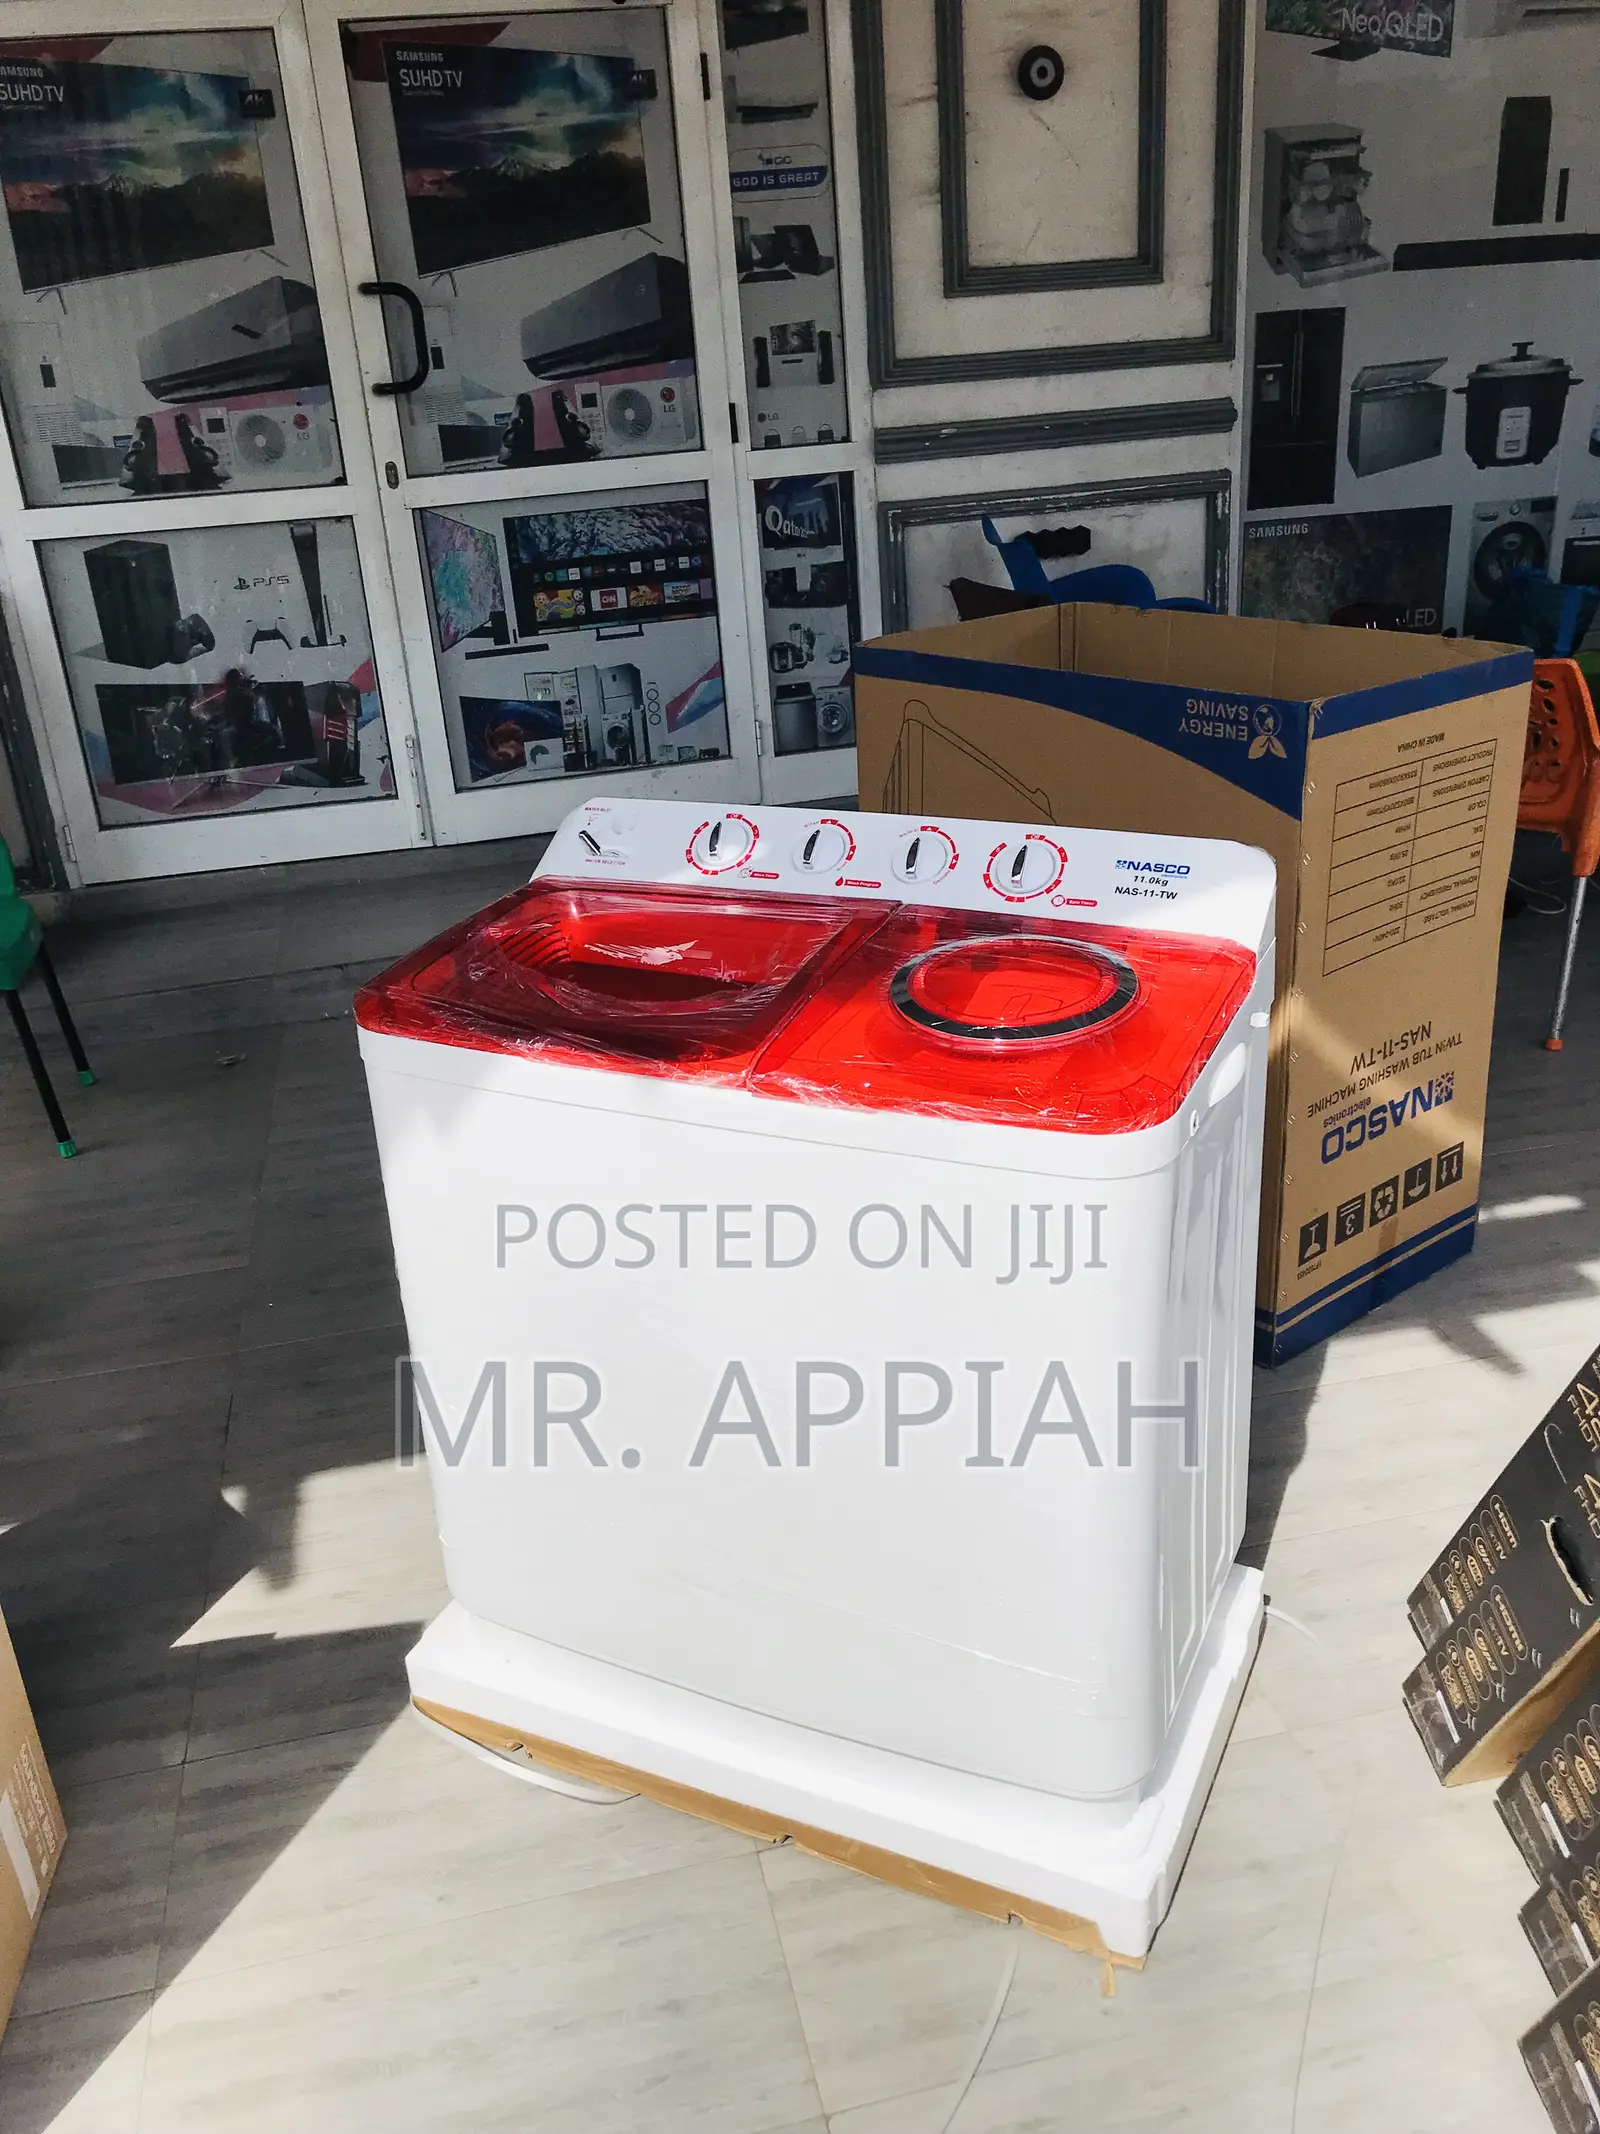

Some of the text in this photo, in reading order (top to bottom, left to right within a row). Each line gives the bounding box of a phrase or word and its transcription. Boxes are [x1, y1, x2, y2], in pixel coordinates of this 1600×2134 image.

[1341, 8, 1444, 42] Neo QLED
[396, 50, 444, 62] SAMSUNG
[0, 66, 44, 78] AMSUNG
[732, 177, 759, 187] GOD
[763, 175, 775, 185] IS
[1249, 523, 1309, 538] SAMSUNG
[253, 575, 290, 587] PS5
[1405, 607, 1437, 628] LED
[1186, 698, 1249, 722] SAVING
[1179, 718, 1248, 742] ENERGY
[1127, 861, 1191, 876] NASCO
[1133, 875, 1169, 888] 11.0kg
[1114, 886, 1178, 900] NAS-11-TW
[1350, 1021, 1432, 1076] NAS-11-TW
[1307, 1032, 1463, 1118] TWIN TUB WASHING MACHINE
[1321, 1079, 1434, 1164] NASCO
[1323, 1096, 1372, 1128] electronics
[1495, 1594, 1523, 1651] HDMI
